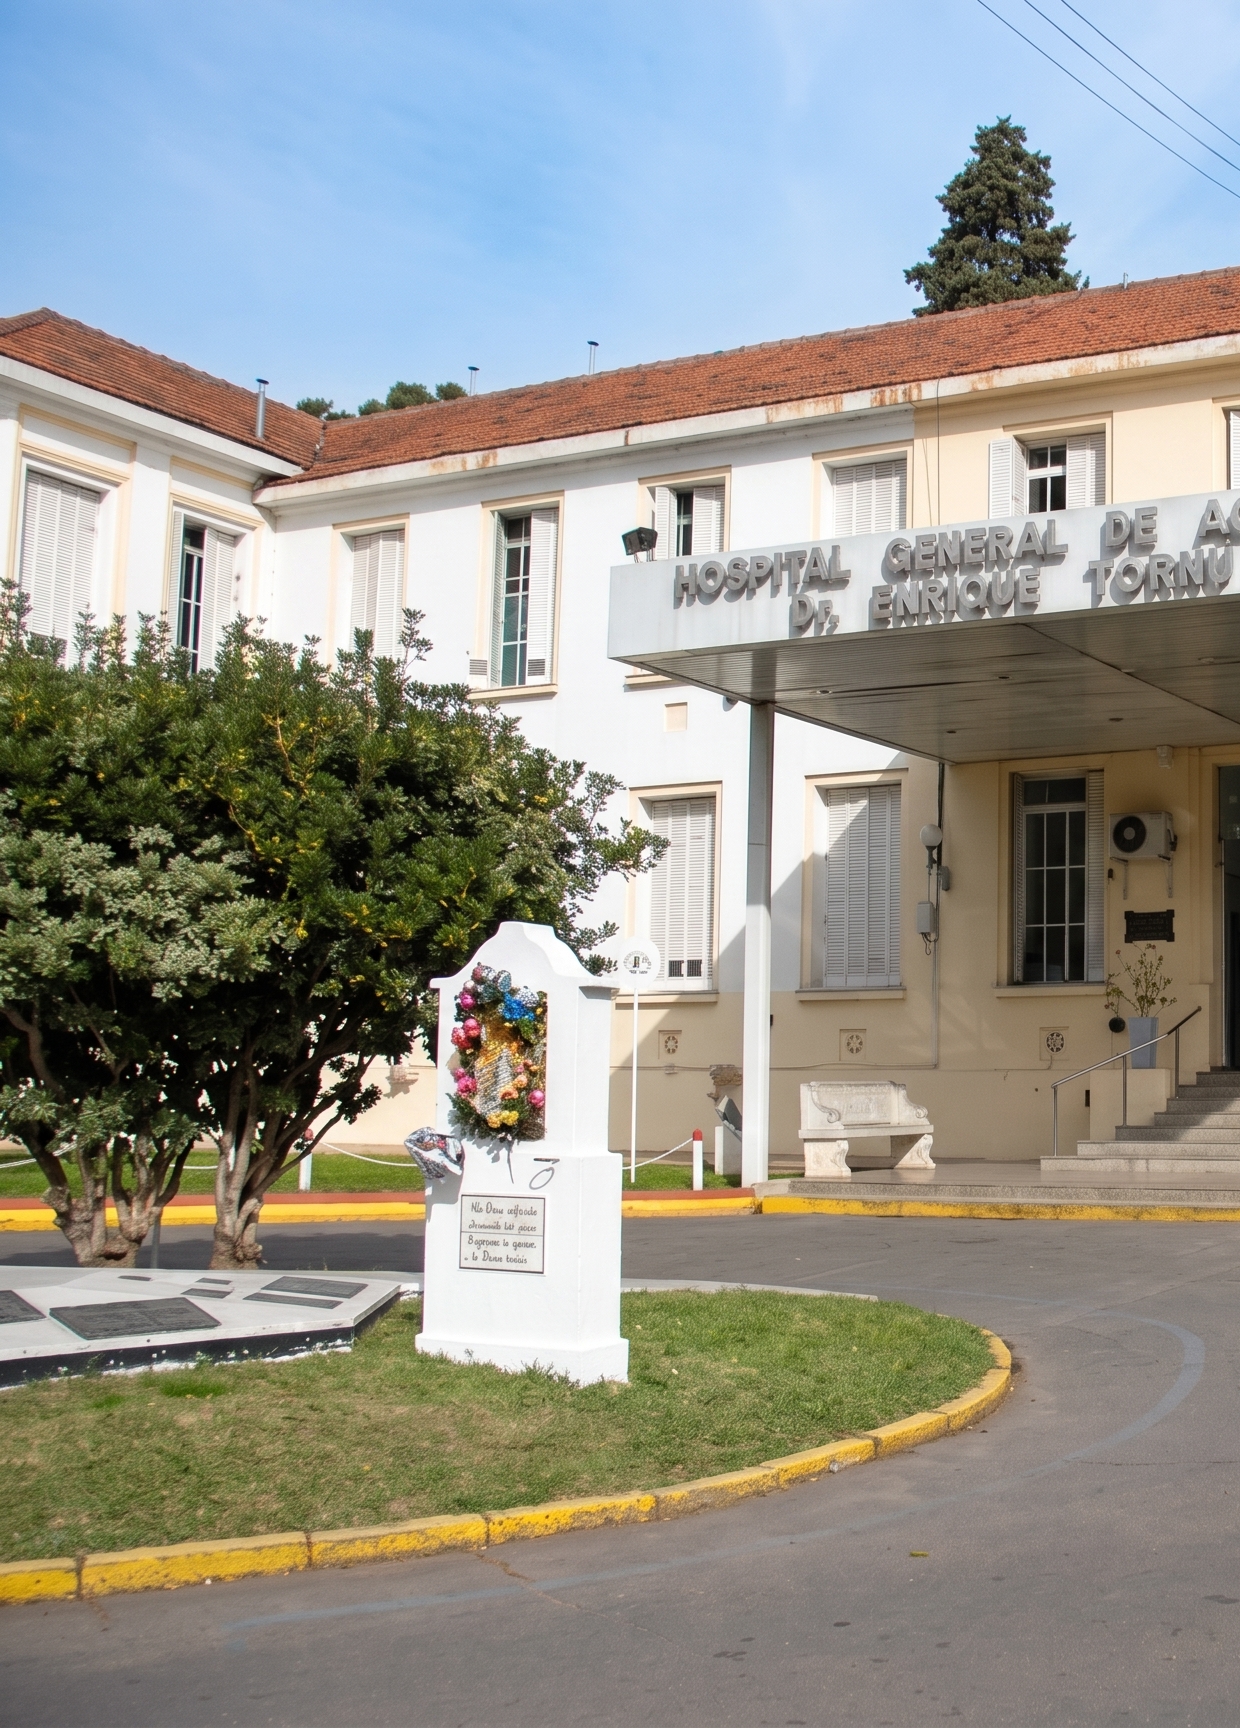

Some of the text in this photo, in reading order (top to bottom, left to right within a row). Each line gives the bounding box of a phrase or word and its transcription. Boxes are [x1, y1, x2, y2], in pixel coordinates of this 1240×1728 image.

[675, 545, 852, 598] HOSPITAL
[886, 519, 1069, 573] GENERAL
[1105, 506, 1158, 547] DE
[872, 567, 1041, 620] ENRIQUE
